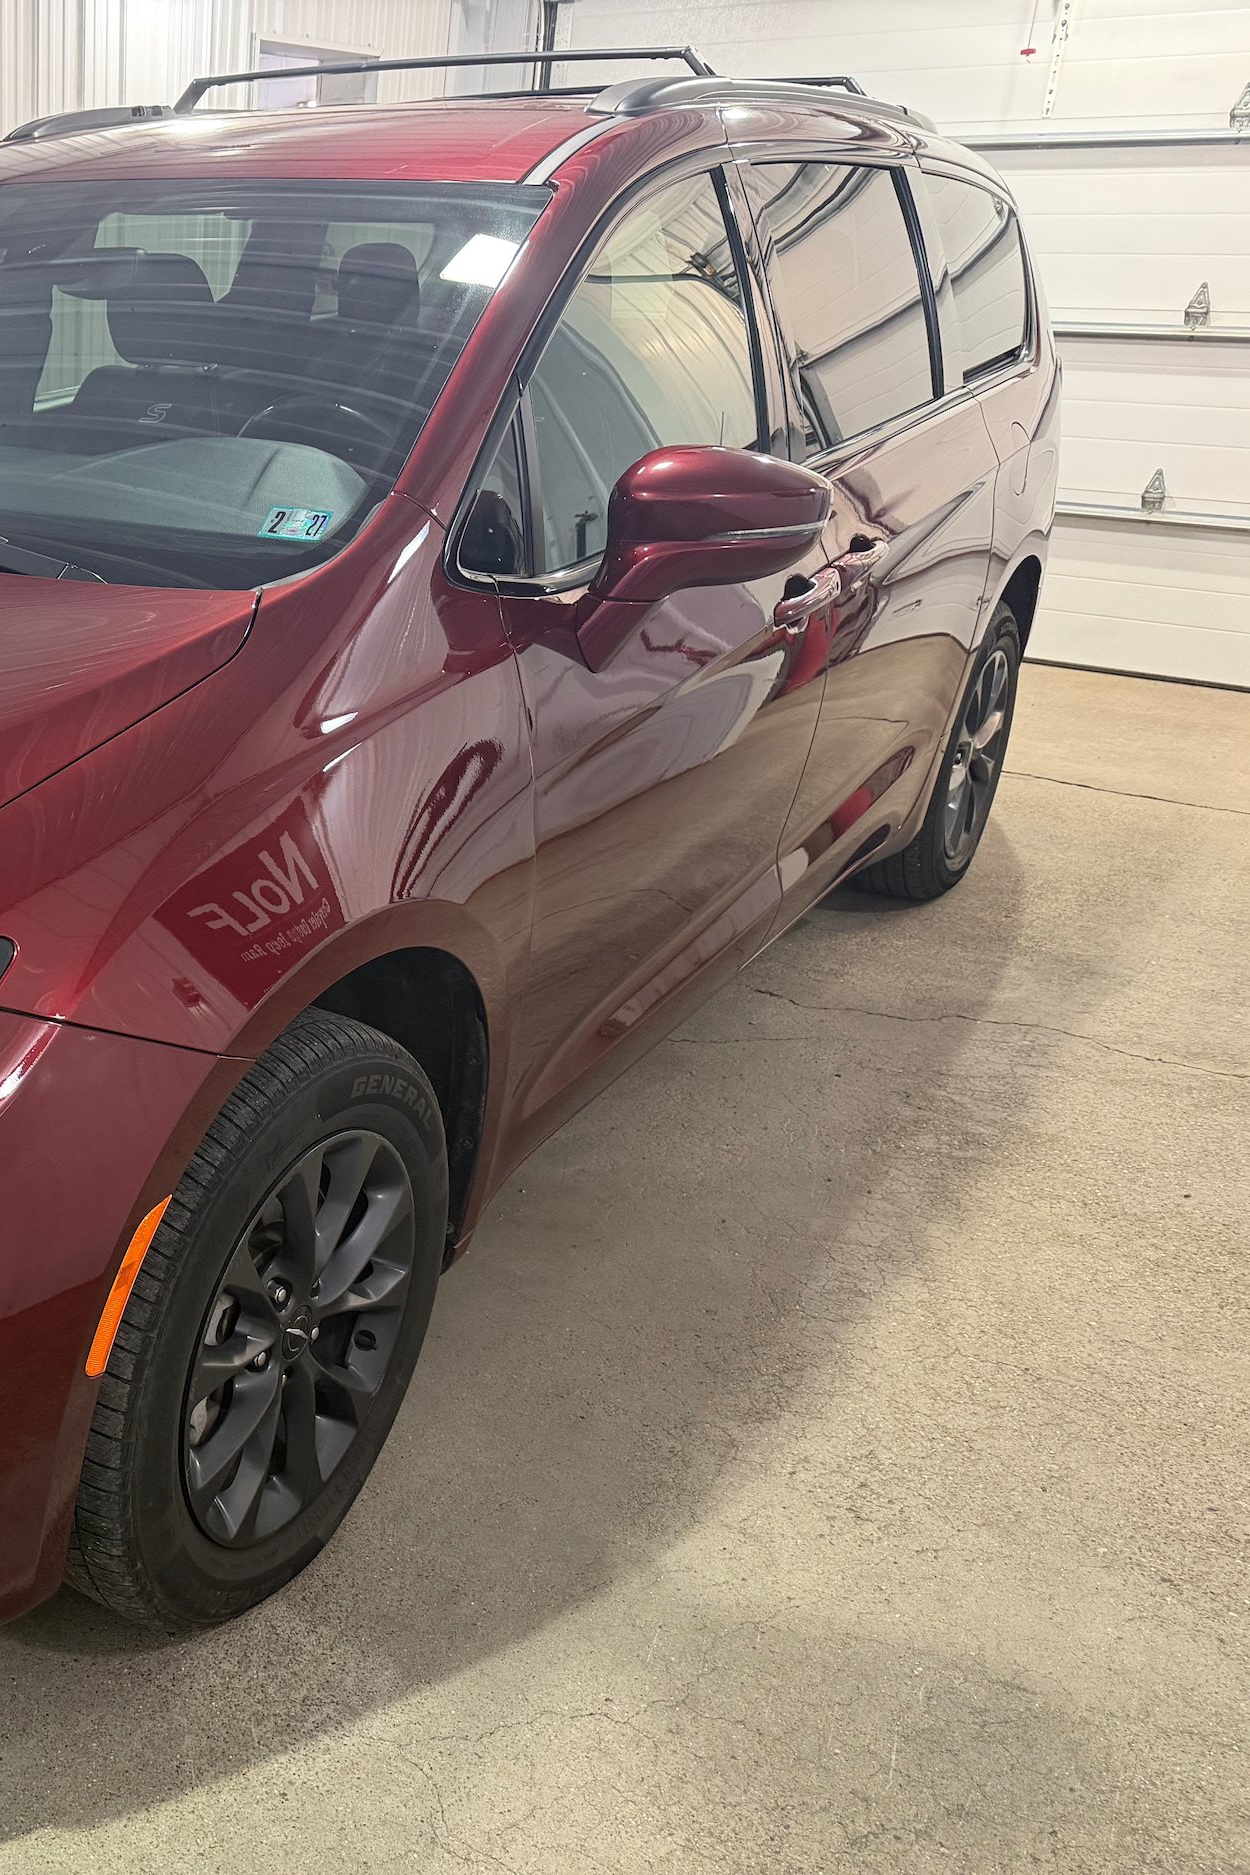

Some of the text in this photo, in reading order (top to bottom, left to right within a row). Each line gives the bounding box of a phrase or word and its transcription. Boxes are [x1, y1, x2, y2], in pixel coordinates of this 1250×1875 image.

[138, 403, 172, 424] S
[267, 511, 287, 534] 2
[305, 514, 328, 537] 27
[351, 1074, 432, 1131] GENERAL
